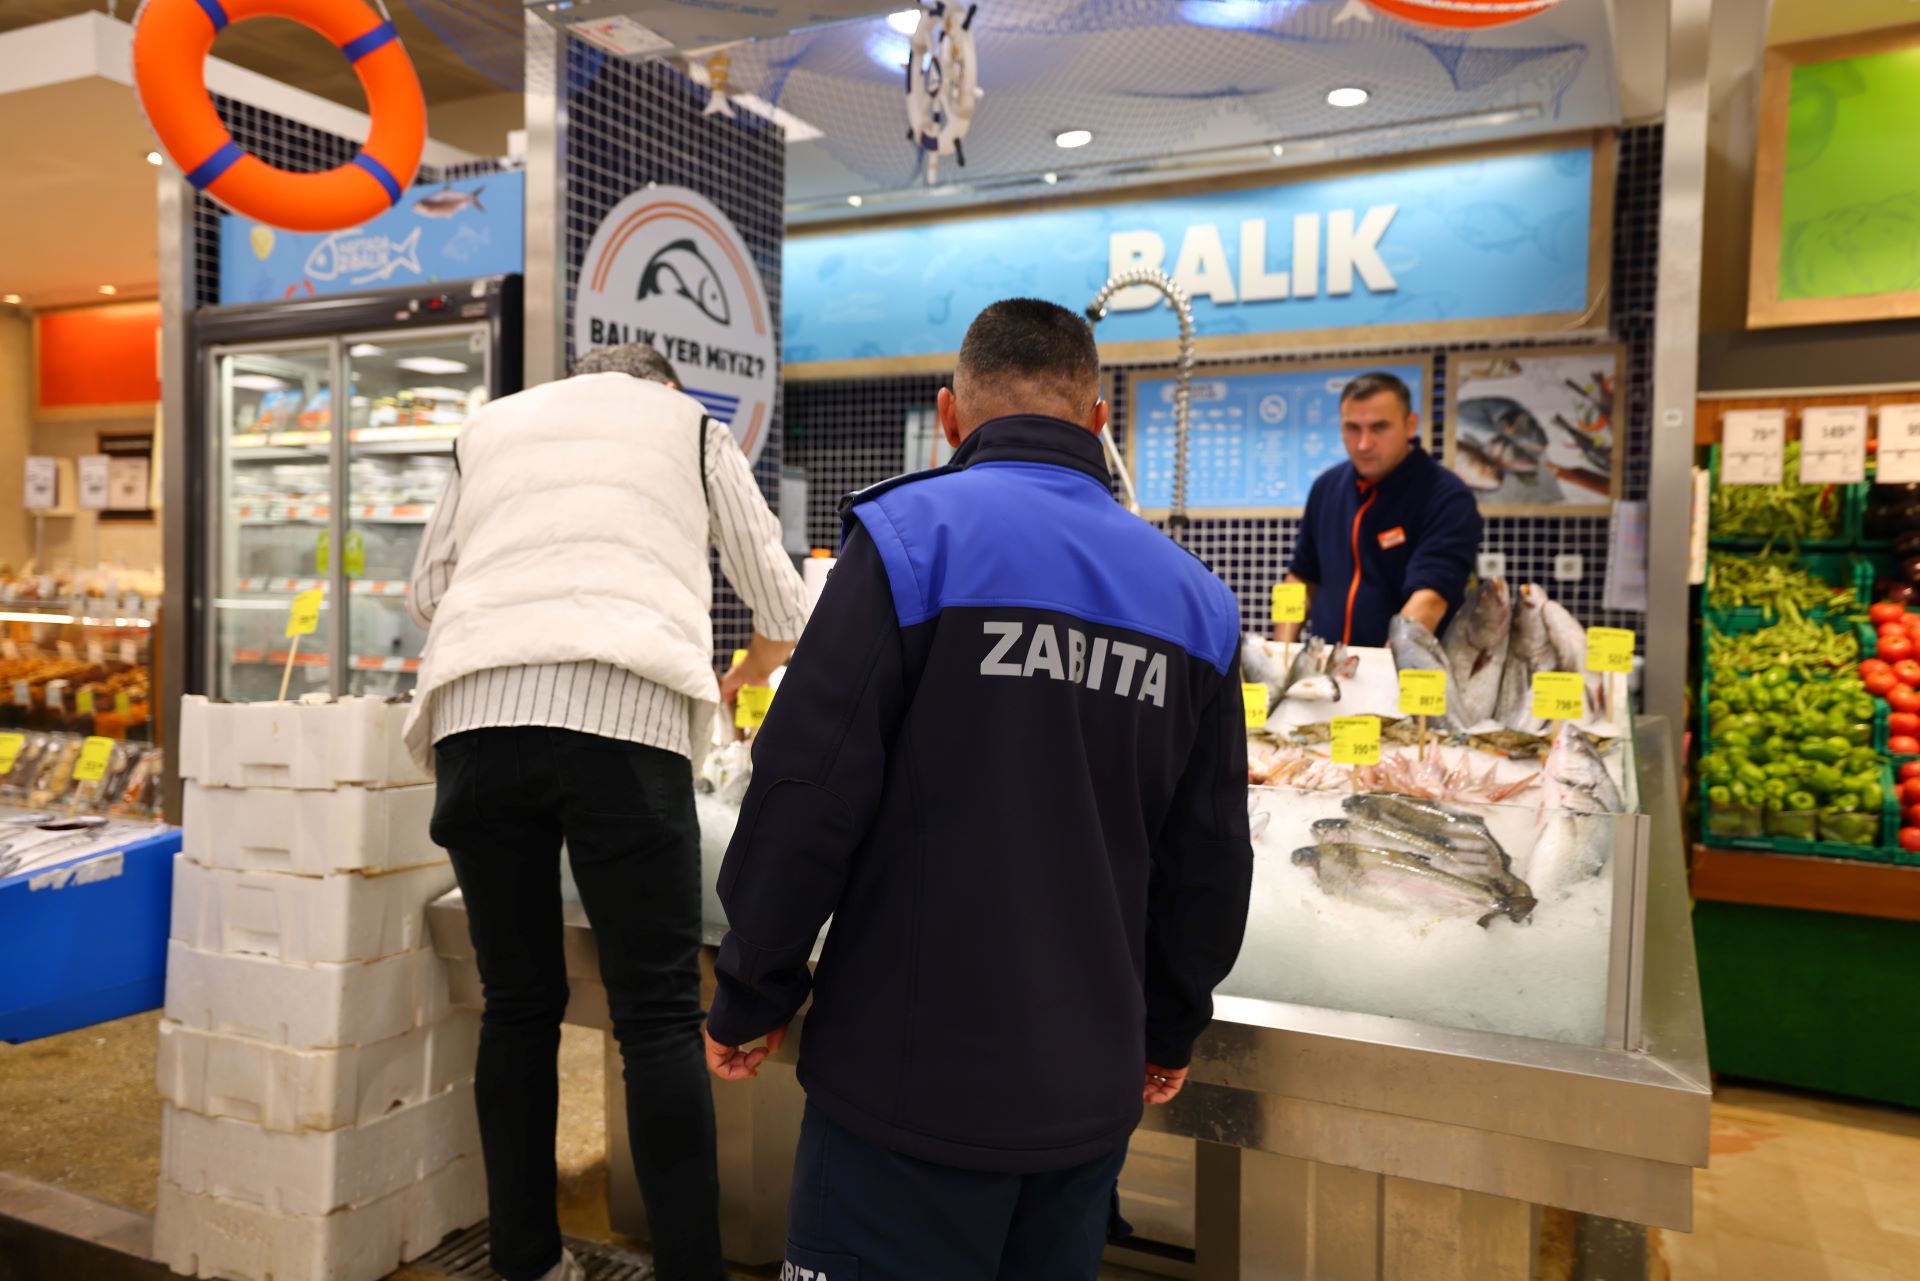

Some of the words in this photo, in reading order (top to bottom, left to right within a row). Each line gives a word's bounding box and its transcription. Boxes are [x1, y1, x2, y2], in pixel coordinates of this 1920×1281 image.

[1109, 204, 1397, 314] BALIK
[663, 333, 701, 365] YER
[980, 621, 1167, 708] ZABITA
